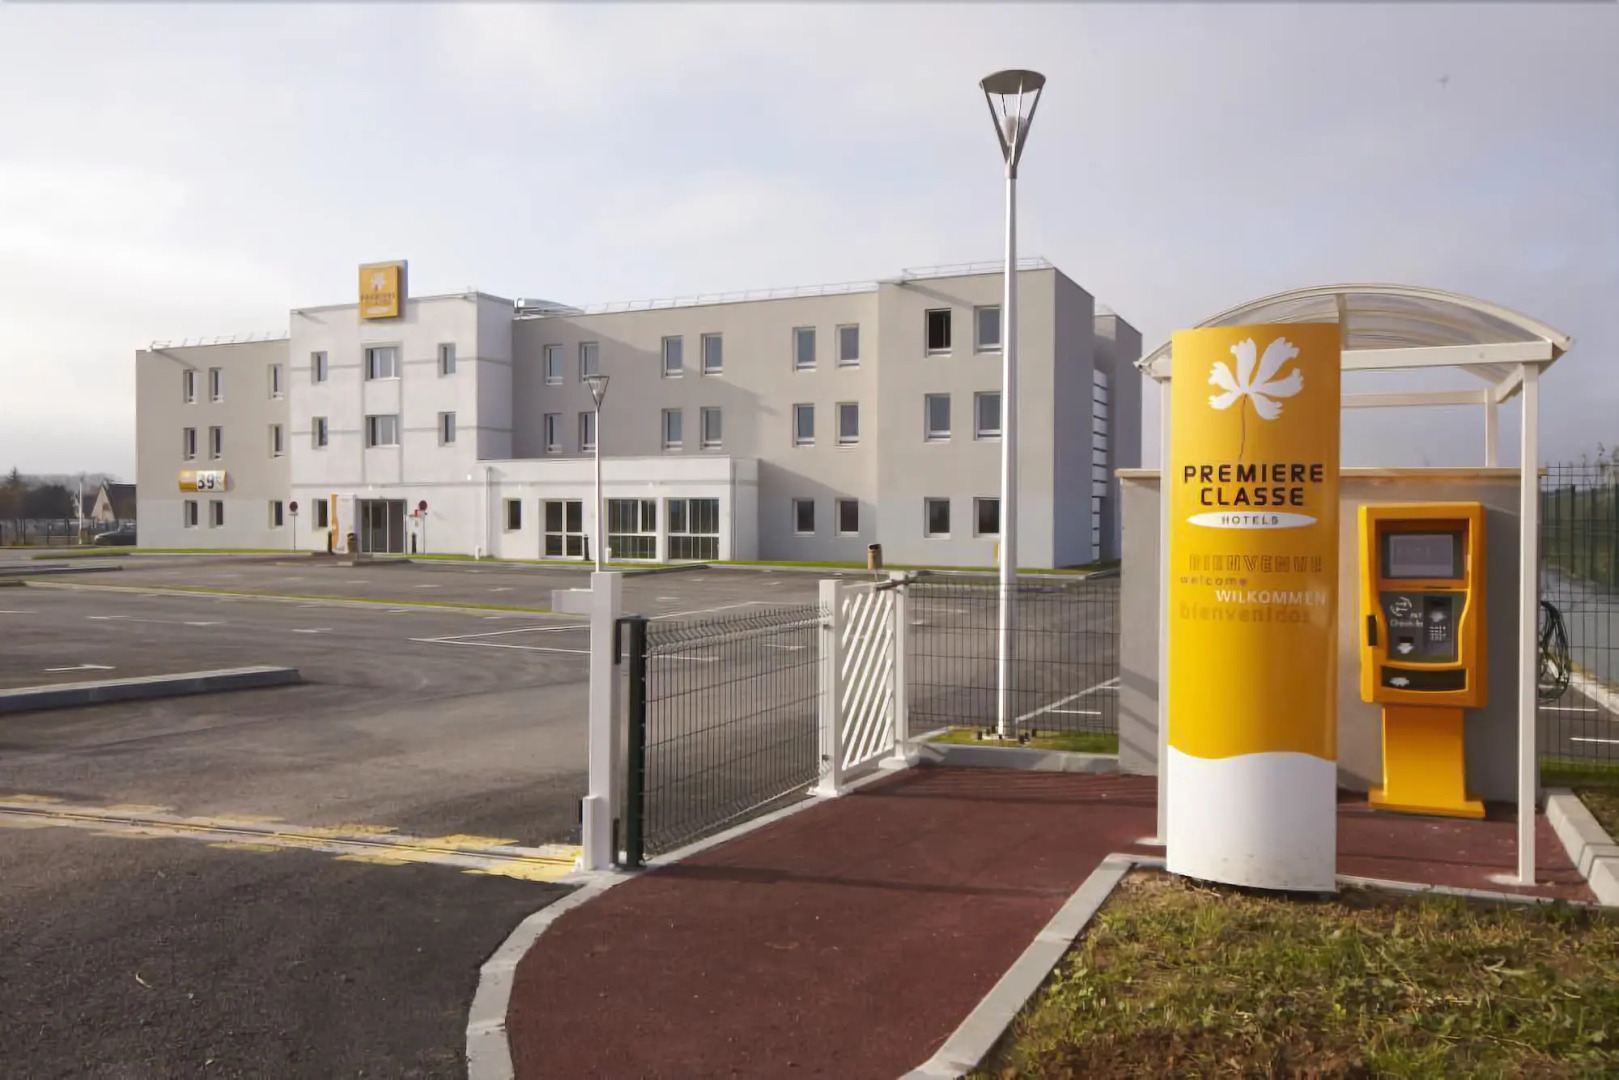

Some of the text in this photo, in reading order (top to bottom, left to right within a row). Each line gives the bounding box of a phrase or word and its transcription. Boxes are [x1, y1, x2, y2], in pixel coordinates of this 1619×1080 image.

[1184, 463, 1323, 483] PREMIERE
[1200, 487, 1304, 506] CLASSE
[1221, 515, 1280, 526] HOTELS
